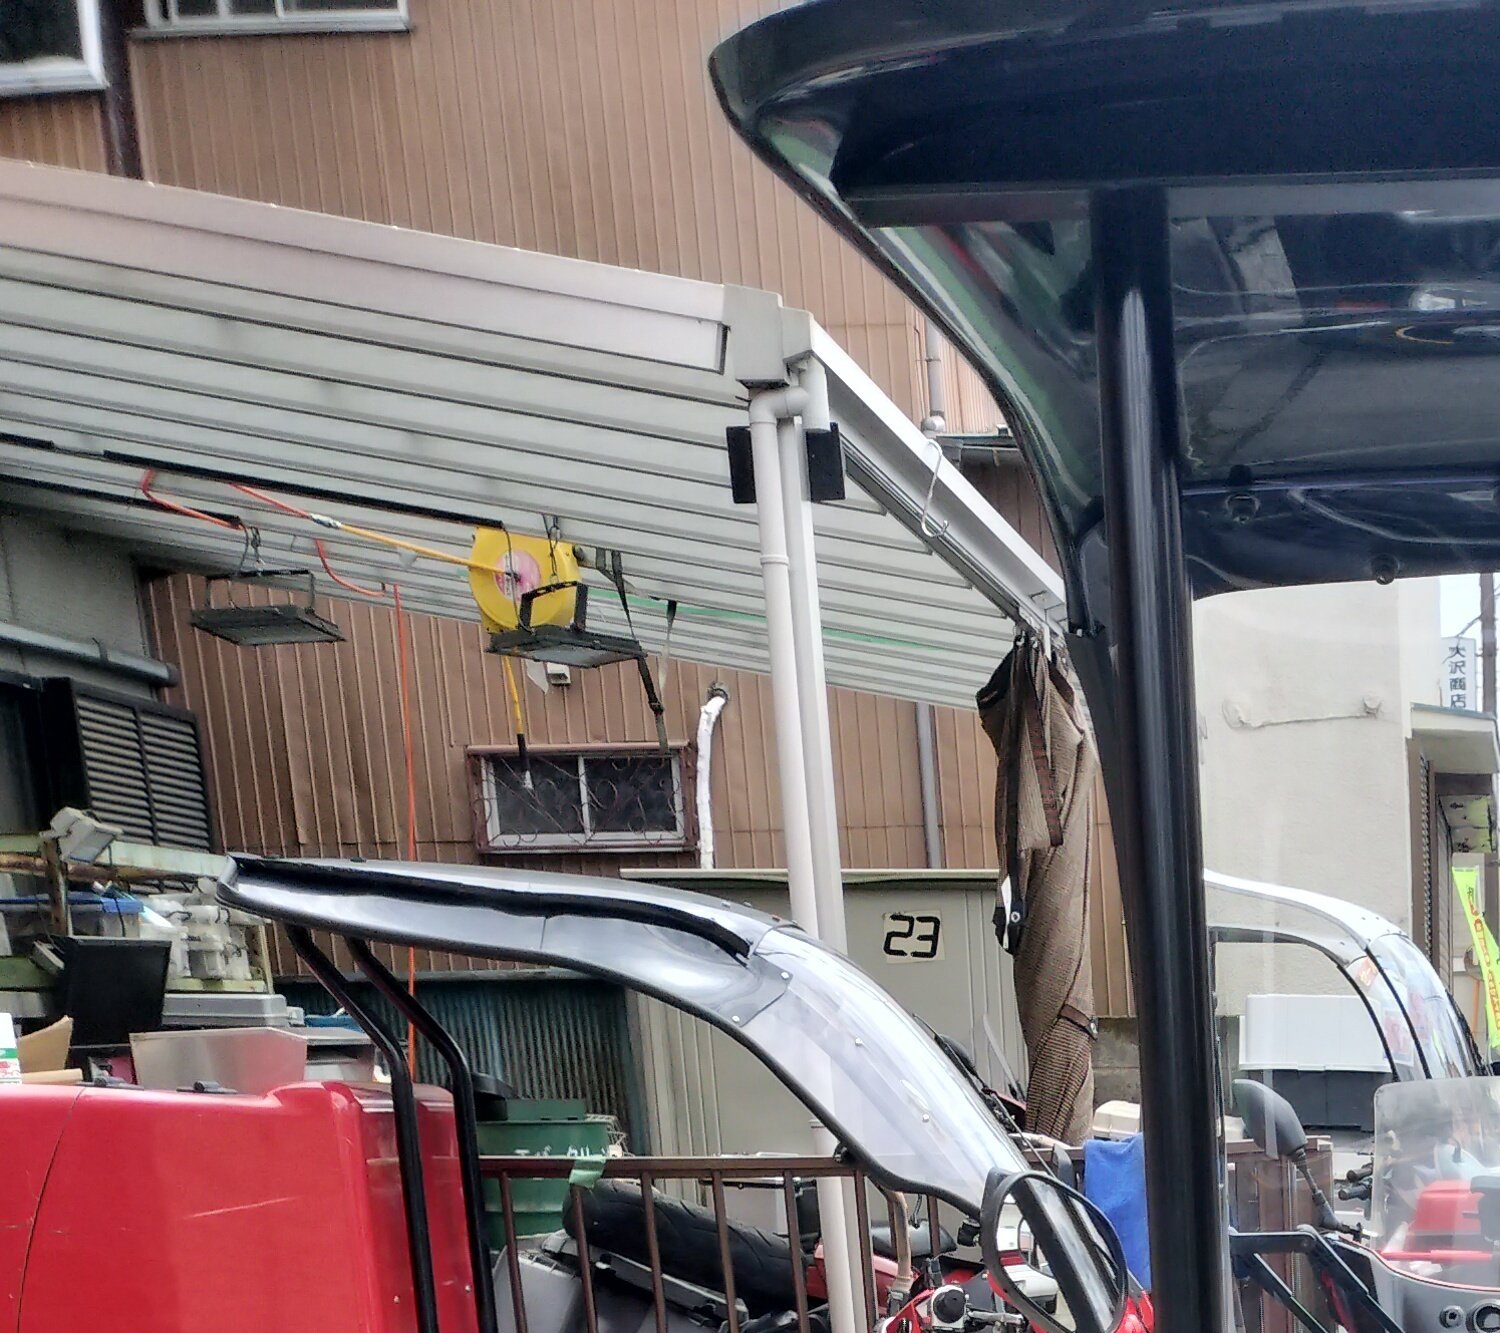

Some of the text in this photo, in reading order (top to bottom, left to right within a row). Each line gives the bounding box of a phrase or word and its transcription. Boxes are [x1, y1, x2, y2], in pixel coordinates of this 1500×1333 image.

[1448, 645, 1466, 708] 大沢商店
[883, 913, 941, 958] 23
